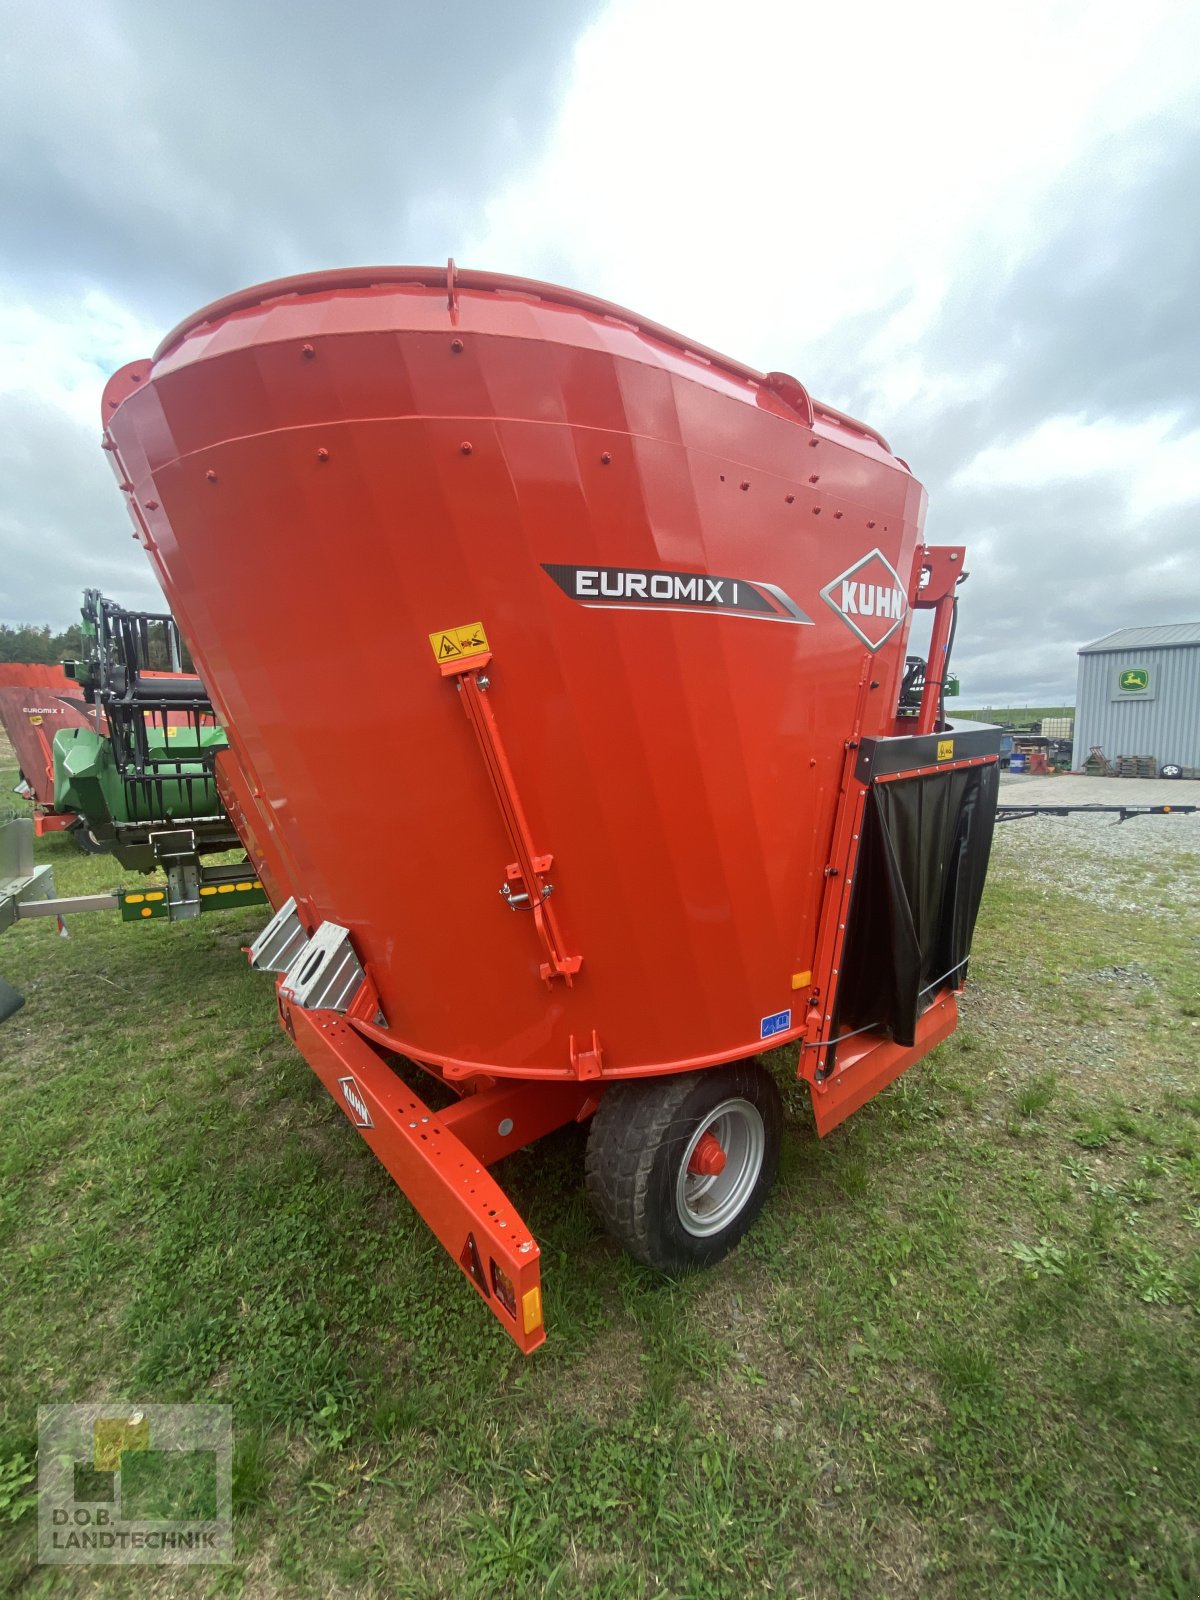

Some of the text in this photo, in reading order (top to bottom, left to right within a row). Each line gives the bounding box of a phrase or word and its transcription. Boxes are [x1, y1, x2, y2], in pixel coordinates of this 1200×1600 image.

[576, 570, 738, 605] EUROMIX I
[841, 580, 902, 620] KUHN
[343, 1081, 368, 1124] KUHN
